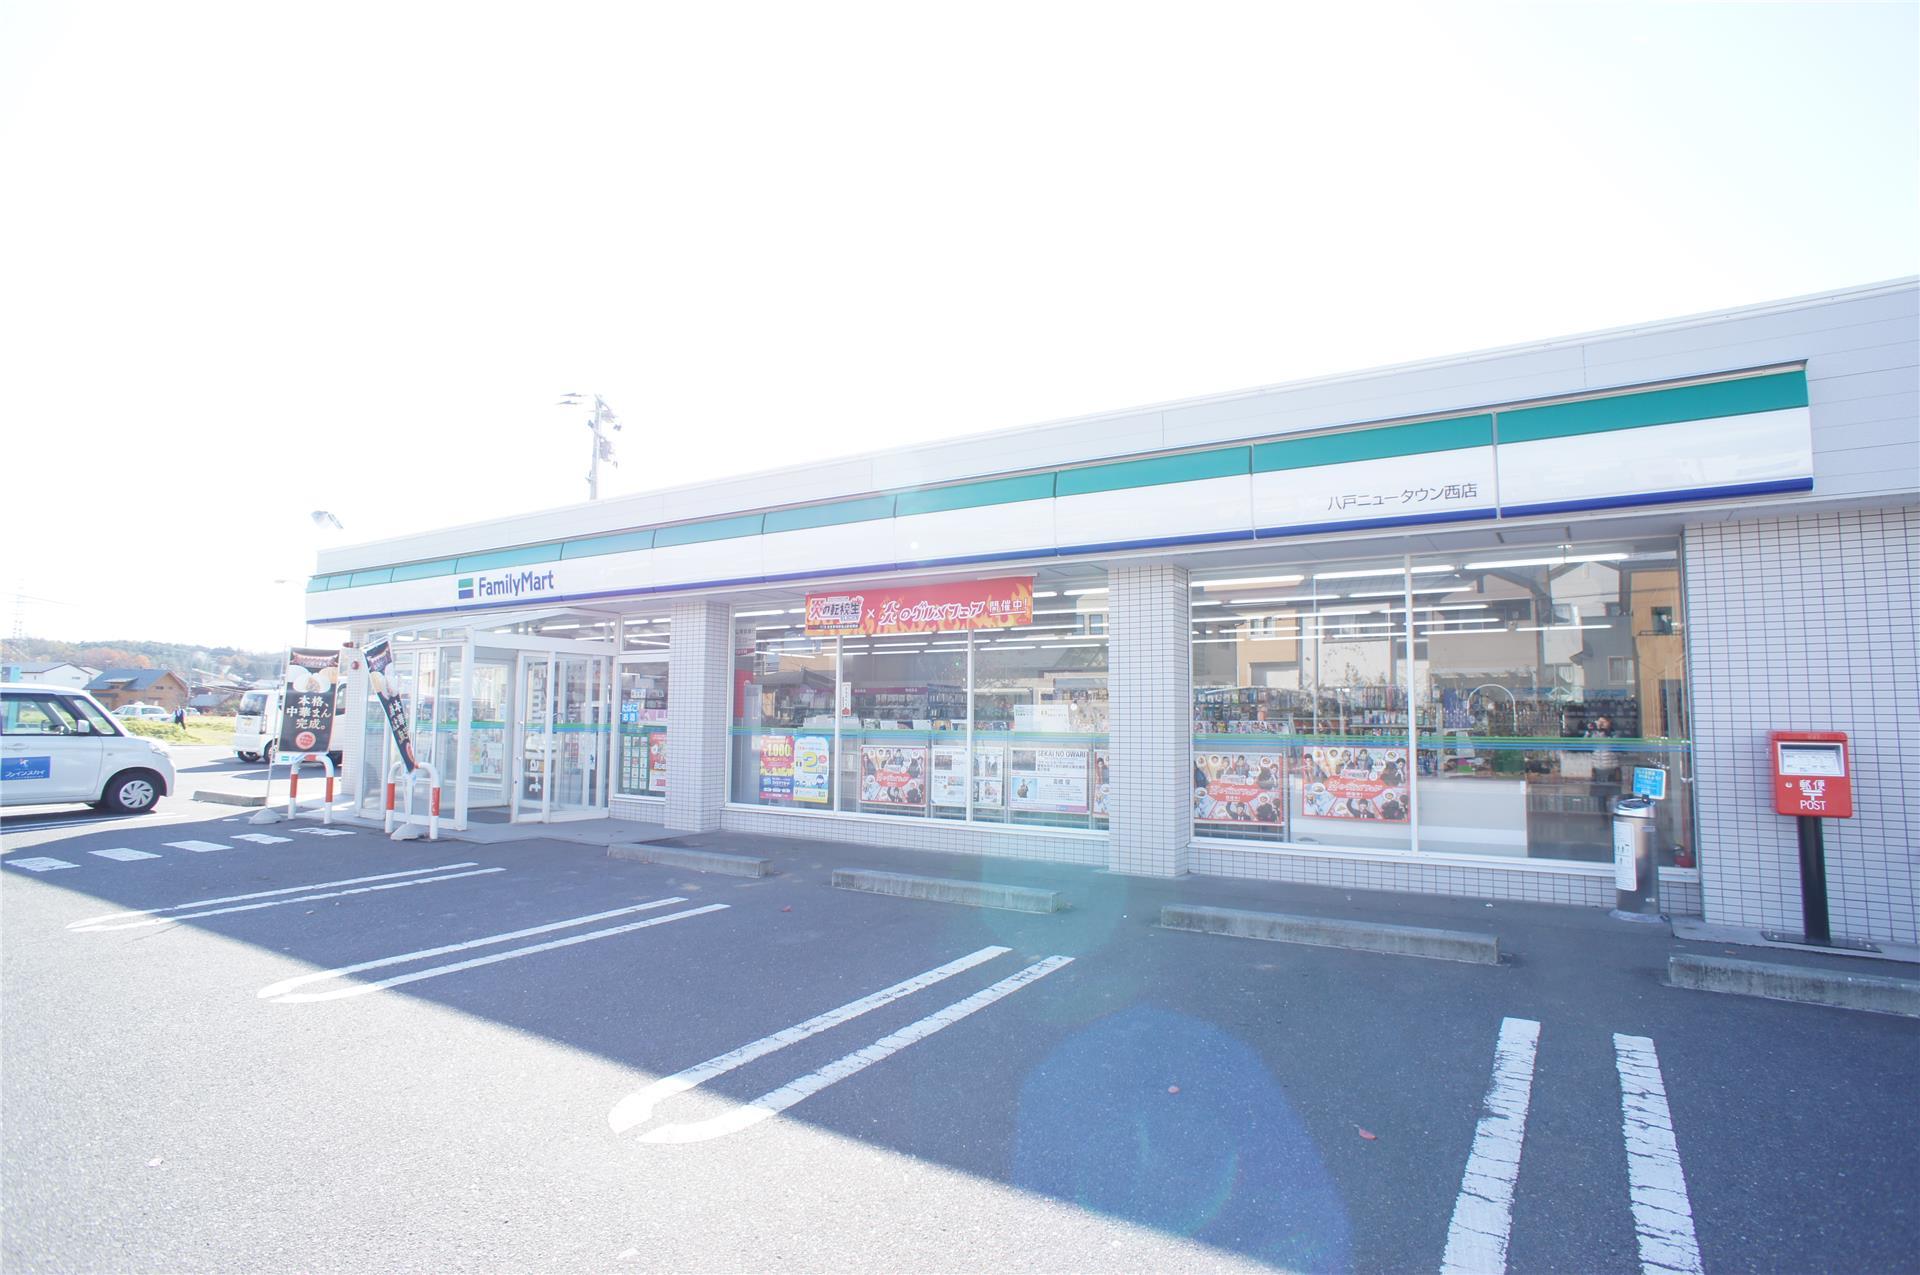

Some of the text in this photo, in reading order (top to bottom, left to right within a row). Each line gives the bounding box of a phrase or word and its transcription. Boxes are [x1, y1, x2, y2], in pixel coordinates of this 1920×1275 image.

[1327, 483, 1478, 511] 八戸ニュータウン西店
[478, 570, 554, 598] FamilyMart
[809, 598, 861, 621] 炎の転校生
[879, 600, 986, 626] 炎のグルメフェア
[286, 705, 332, 718] 中華まん
[1799, 779, 1826, 791] 郵便
[1800, 800, 1827, 811] POST
